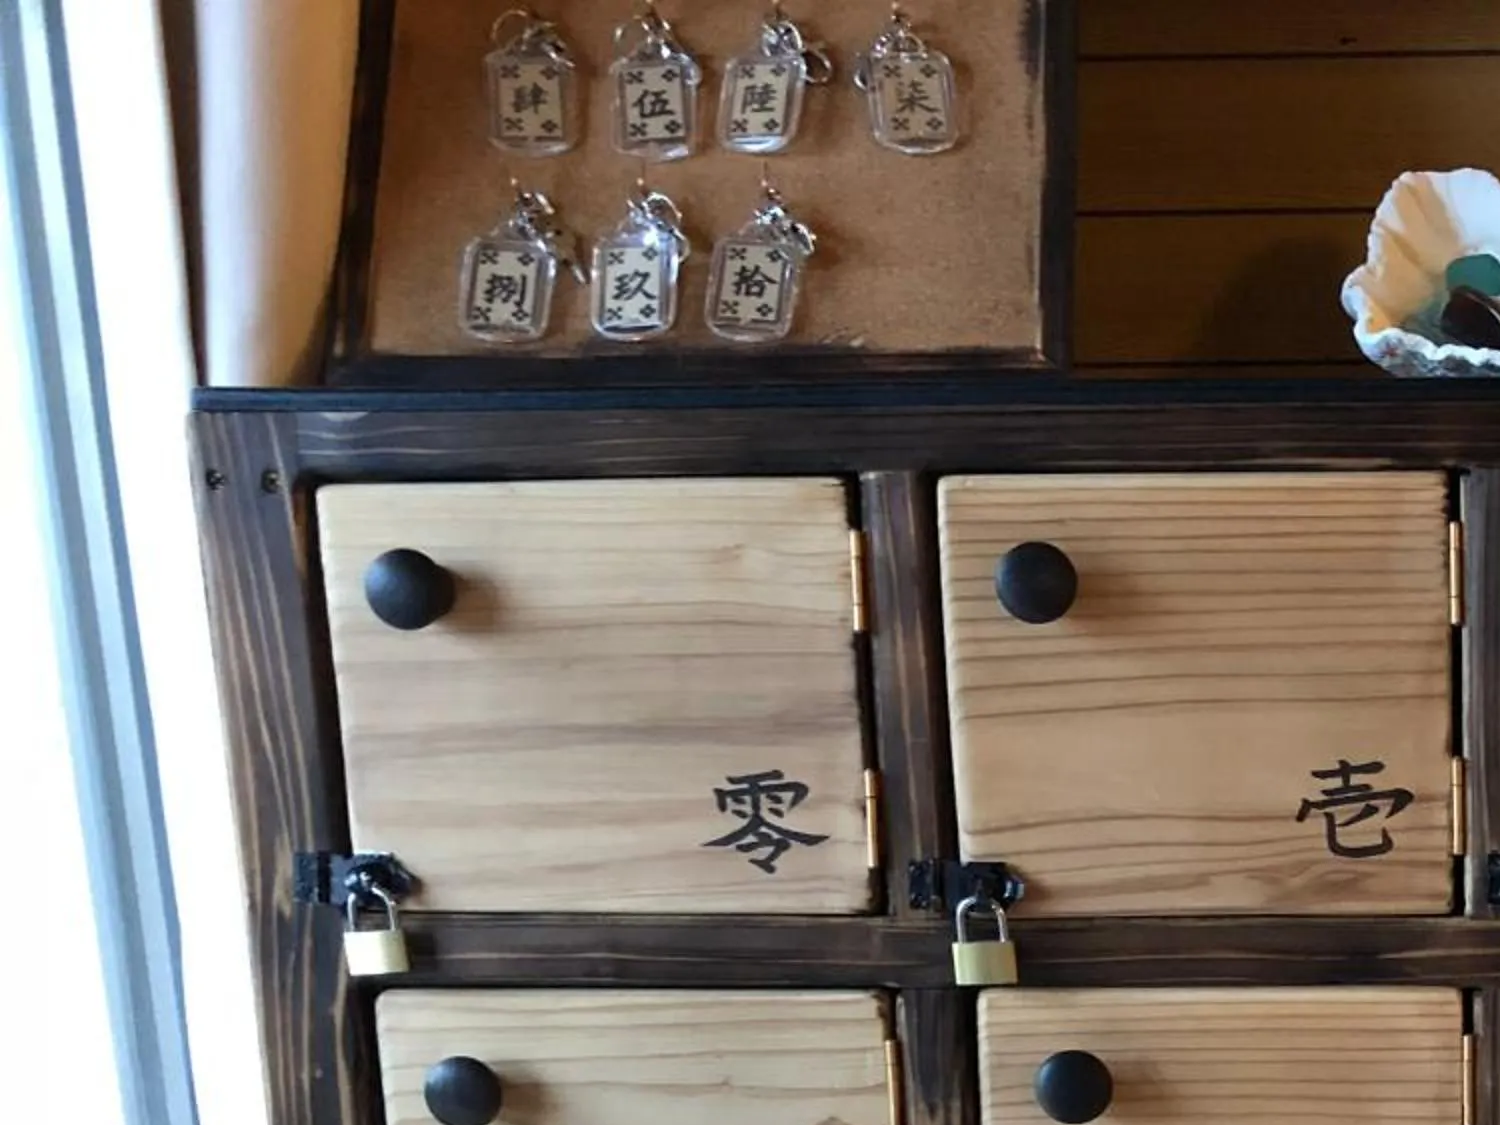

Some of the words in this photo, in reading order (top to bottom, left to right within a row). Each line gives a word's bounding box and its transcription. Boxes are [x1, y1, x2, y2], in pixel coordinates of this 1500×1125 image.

[631, 88, 676, 120] 伍
[742, 82, 778, 115] 陸
[895, 81, 940, 115] 柒
[482, 272, 527, 311] 捌
[611, 267, 658, 303] 玖
[732, 264, 778, 300] 拾
[703, 769, 830, 874] 零
[1295, 760, 1415, 859] 壱
